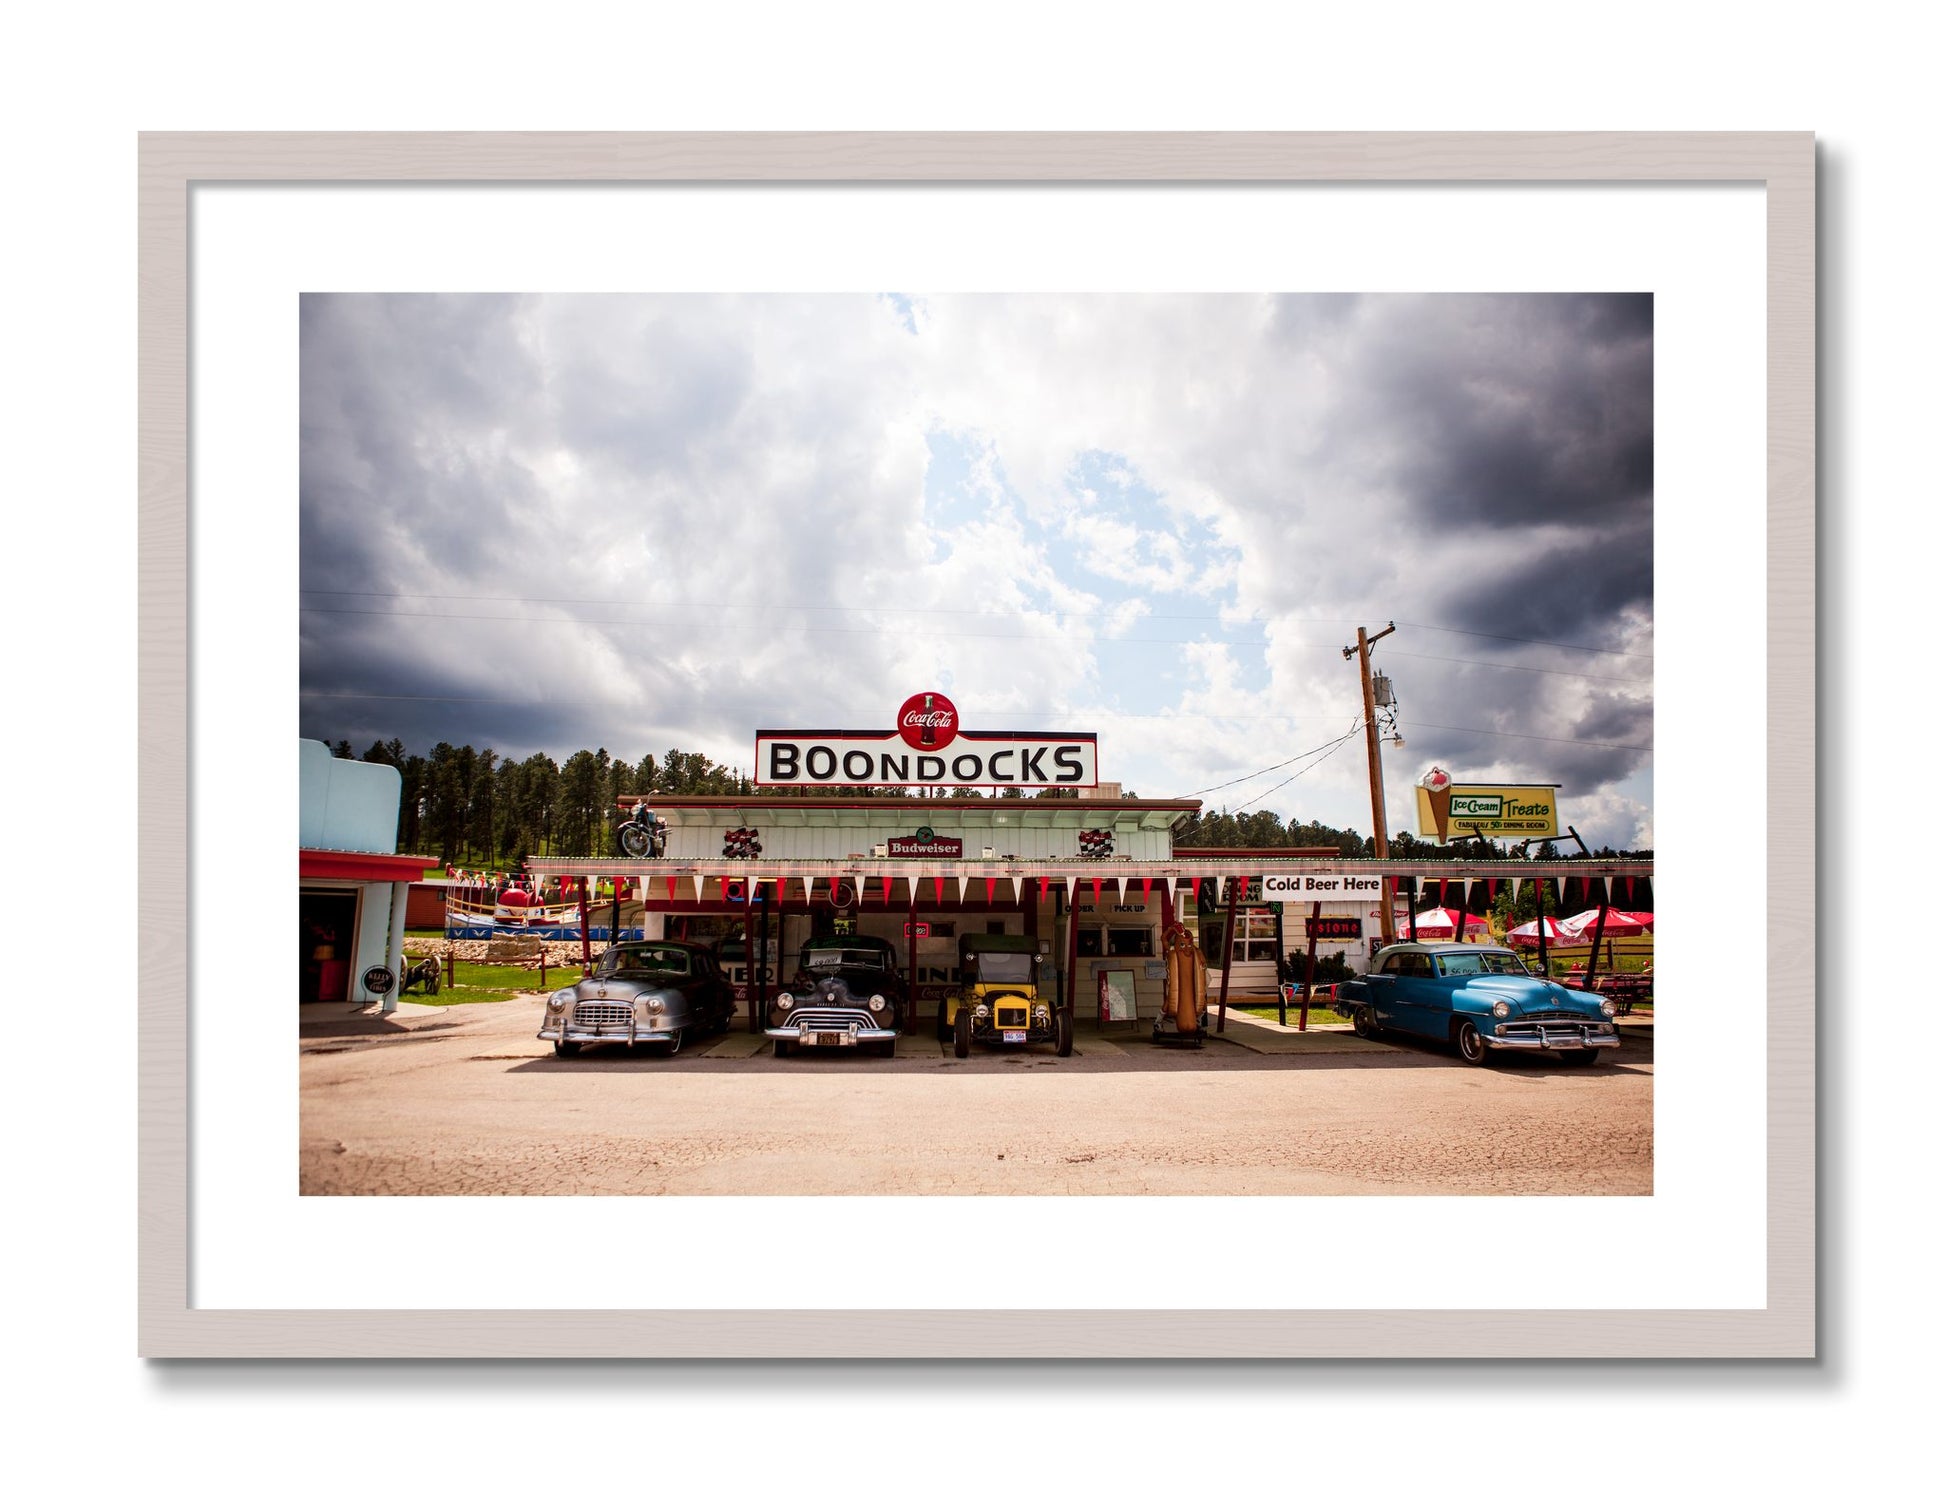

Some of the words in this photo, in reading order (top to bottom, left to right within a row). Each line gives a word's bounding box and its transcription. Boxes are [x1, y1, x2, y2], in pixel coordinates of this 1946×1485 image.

[903, 710, 953, 728] Coca-Cola
[770, 743, 1084, 782] BOONDOCKS
[1467, 800, 1499, 813] Cream
[1503, 799, 1550, 818] Treats
[892, 843, 959, 854] Budweiser
[1266, 878, 1300, 891] Cold
[1306, 878, 1339, 891] Beer
[1344, 878, 1380, 891] Here
